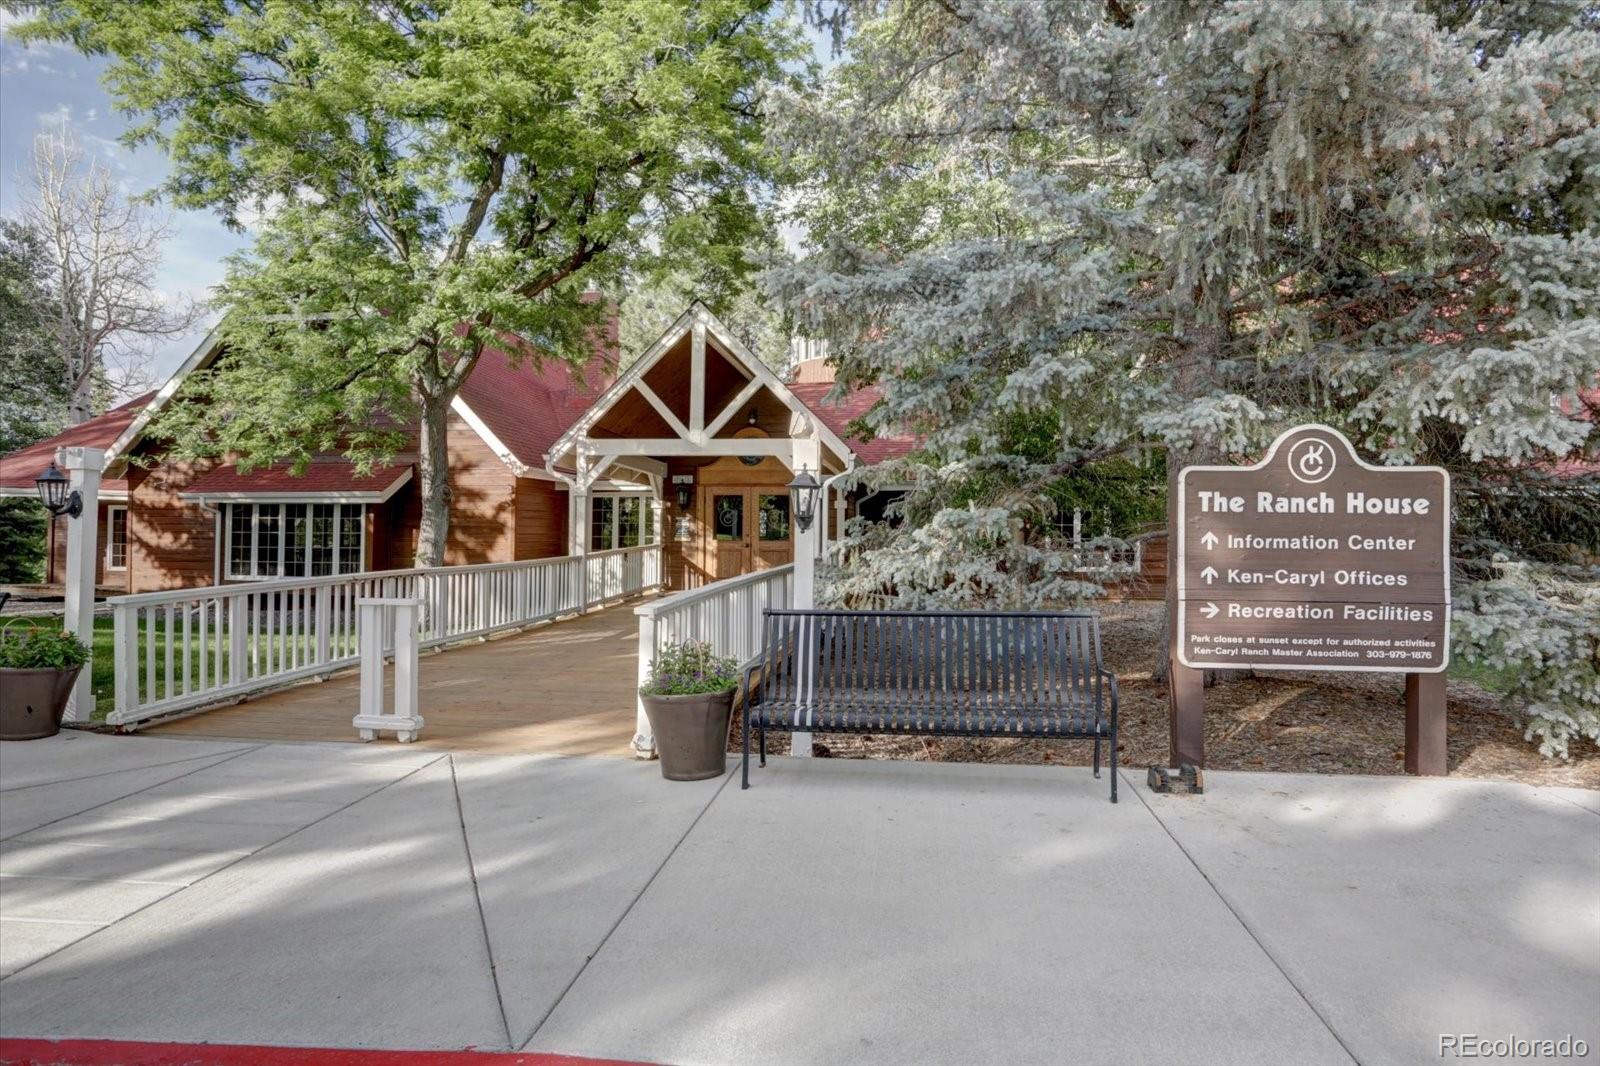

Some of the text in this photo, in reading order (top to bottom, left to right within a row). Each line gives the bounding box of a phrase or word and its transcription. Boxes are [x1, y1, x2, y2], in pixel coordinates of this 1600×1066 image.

[1198, 491, 1429, 514] The Ranch House
[1228, 534, 1415, 550] Information Center
[1228, 569, 1407, 586] Ken-Caryl Offices
[1228, 604, 1433, 621] Recreation Facilities
[1191, 635, 1210, 643] Park
[1214, 635, 1242, 644] closes
[1259, 637, 1288, 645] sunset
[1292, 638, 1323, 647] except
[1343, 638, 1390, 647] authorized
[1394, 639, 1435, 647] activities
[1194, 647, 1432, 659] Ken-Caryl Ranch Master Association 303-979-1876
